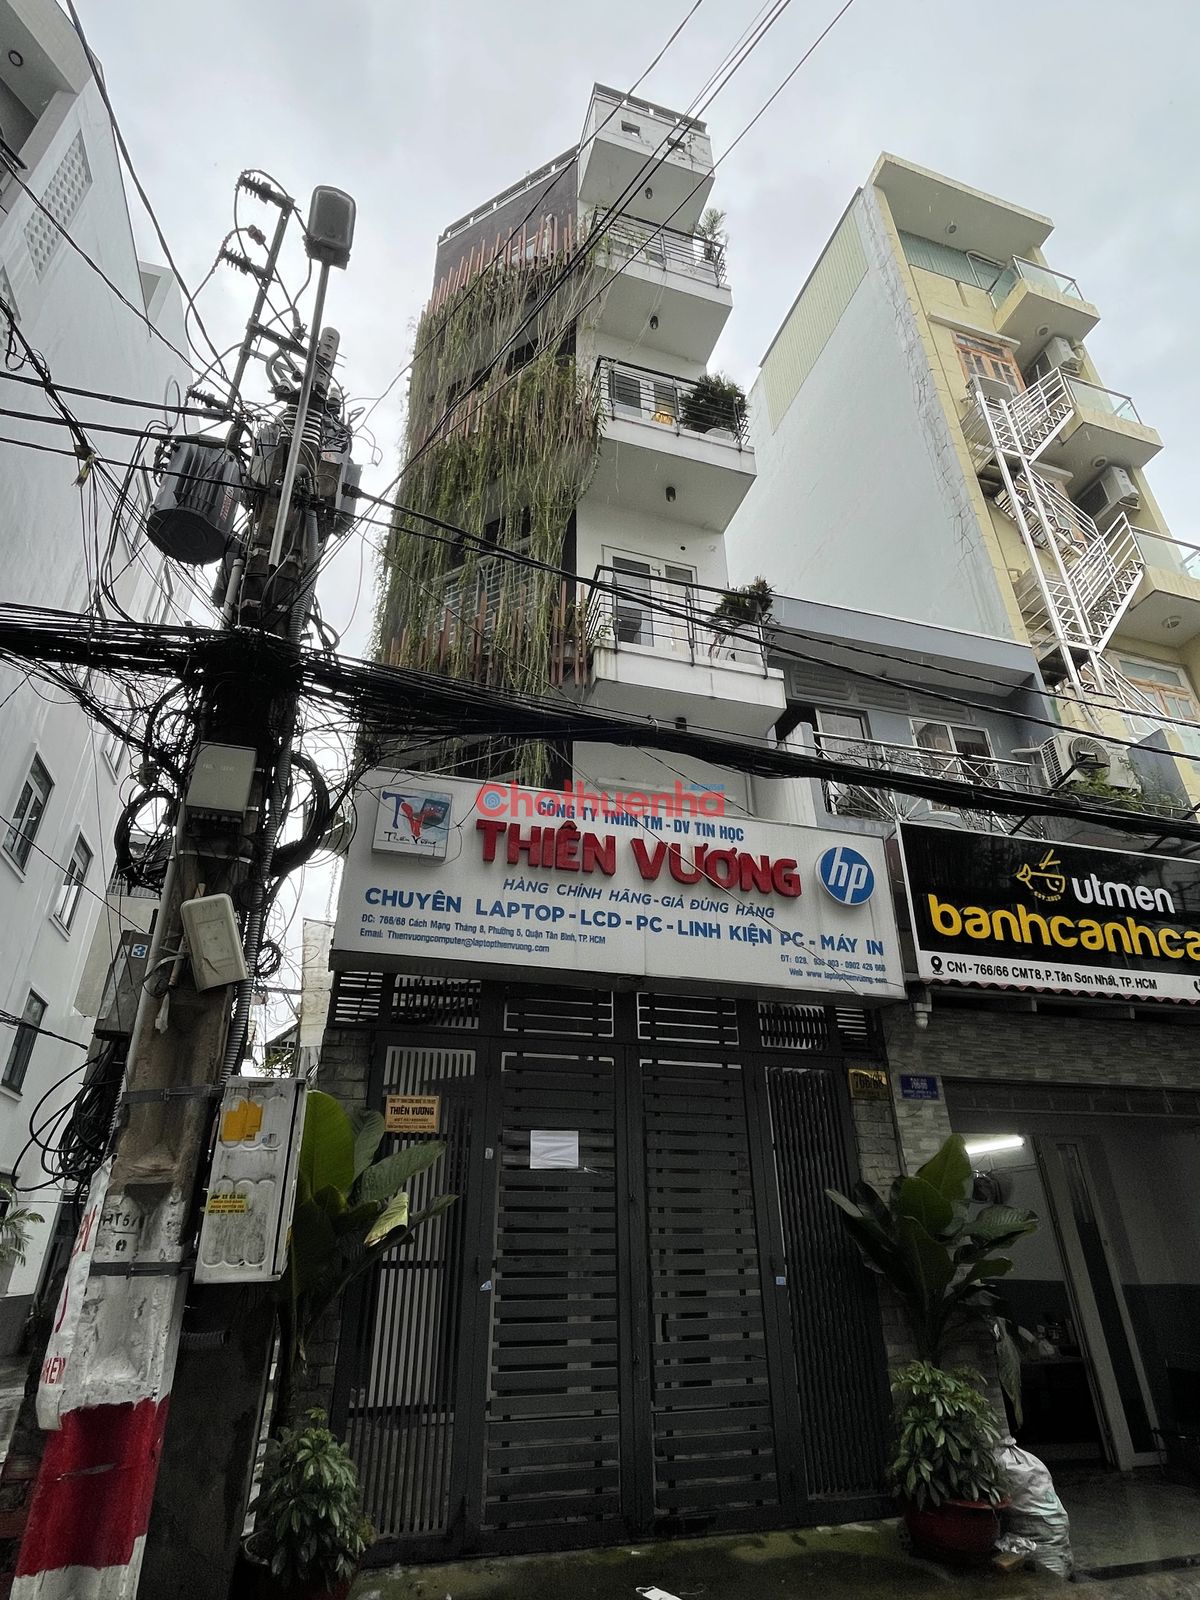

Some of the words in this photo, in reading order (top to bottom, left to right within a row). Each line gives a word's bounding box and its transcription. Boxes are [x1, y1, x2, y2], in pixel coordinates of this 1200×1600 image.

[537, 800, 575, 819] CÔNG
[581, 806, 598, 822] TY
[602, 810, 638, 828] TNHH
[643, 815, 662, 830] TM
[674, 819, 690, 834] DV
[695, 822, 715, 838] TIN
[720, 825, 744, 843] HỌC
[476, 819, 616, 877] THIÊN
[630, 838, 802, 898] VƯƠNG
[828, 847, 868, 904] hp
[503, 876, 549, 894] HÀNG
[557, 883, 602, 899] CHÍNH
[690, 897, 729, 913] ĐÚNG
[736, 902, 775, 918] HÃNG
[365, 887, 461, 913] CHUYÊN
[476, 898, 565, 922] LAPTOP
[580, 909, 622, 928] LCD
[636, 915, 662, 933] PC
[677, 920, 720, 939] LINH
[729, 923, 773, 946] KIỆN
[780, 931, 804, 947] PC
[820, 933, 858, 953] MÁY
[866, 940, 884, 956] IN
[133, 945, 146, 957] 3
[1056, 971, 1072, 982] Tân
[1074, 973, 1093, 985] Sơn
